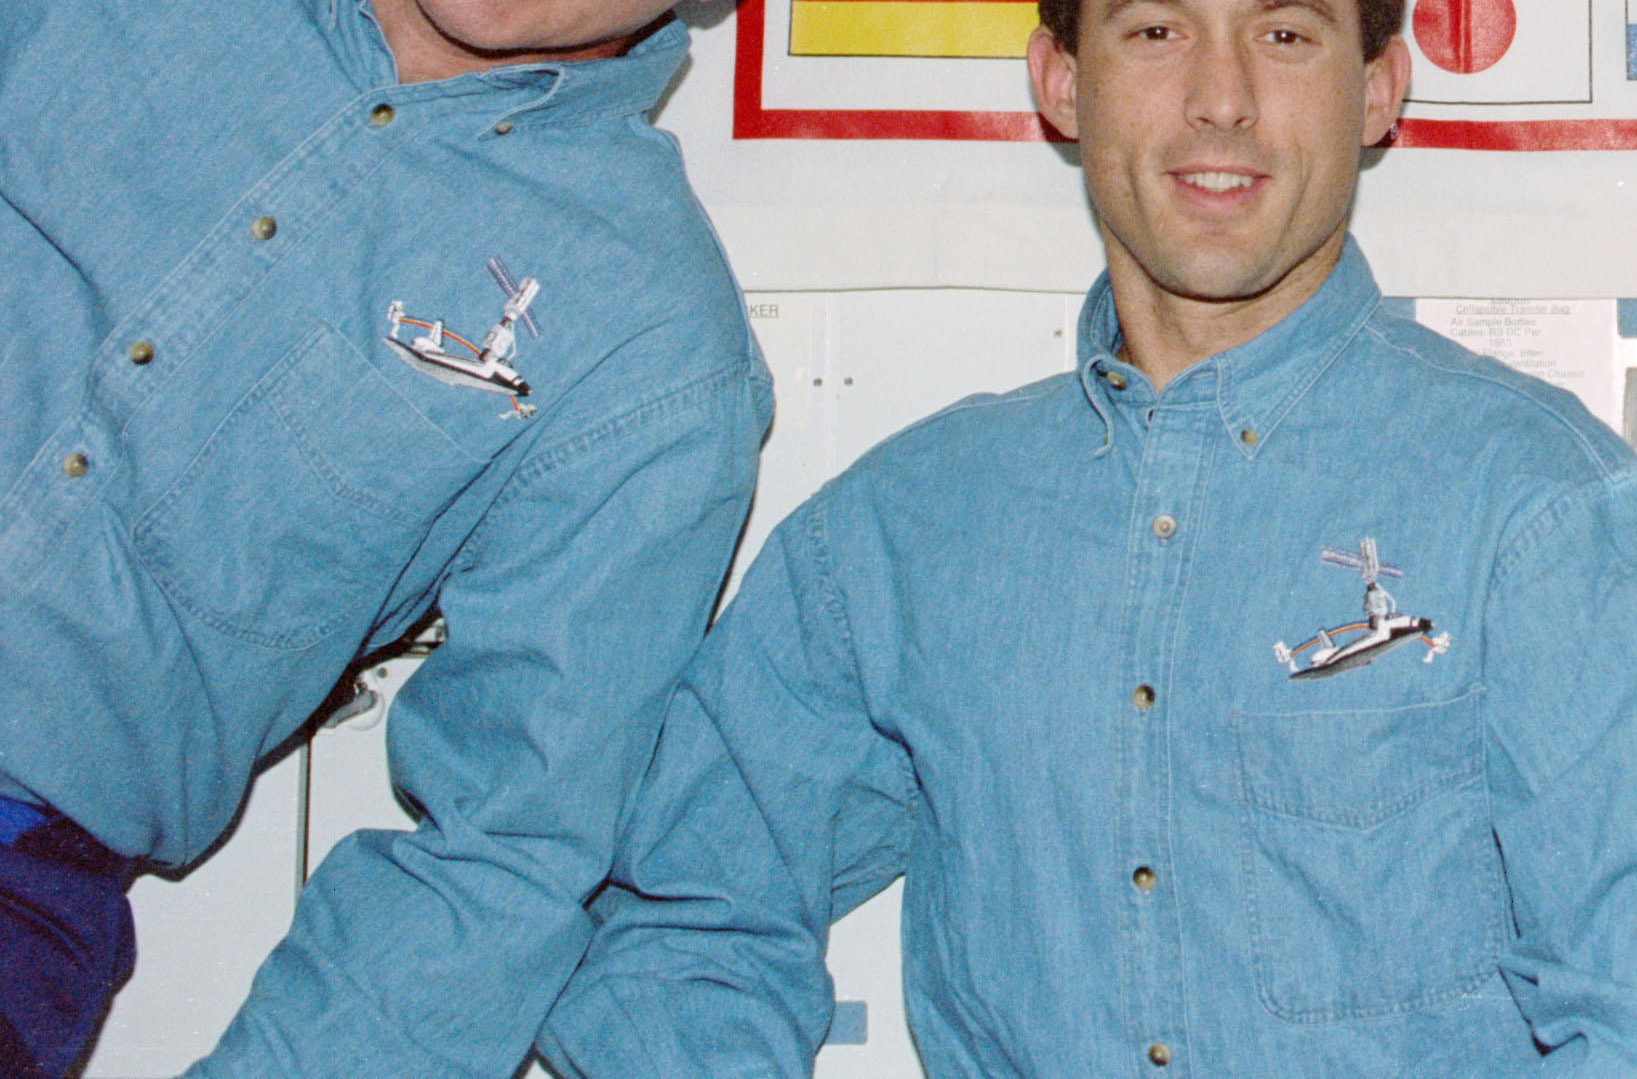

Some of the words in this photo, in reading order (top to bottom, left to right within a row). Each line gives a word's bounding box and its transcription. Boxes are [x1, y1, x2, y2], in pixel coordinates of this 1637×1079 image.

[745, 304, 779, 316] KER
[1551, 303, 1570, 316] Bag
[1466, 317, 1502, 329] Sample
[1505, 317, 1537, 327] Bottles
